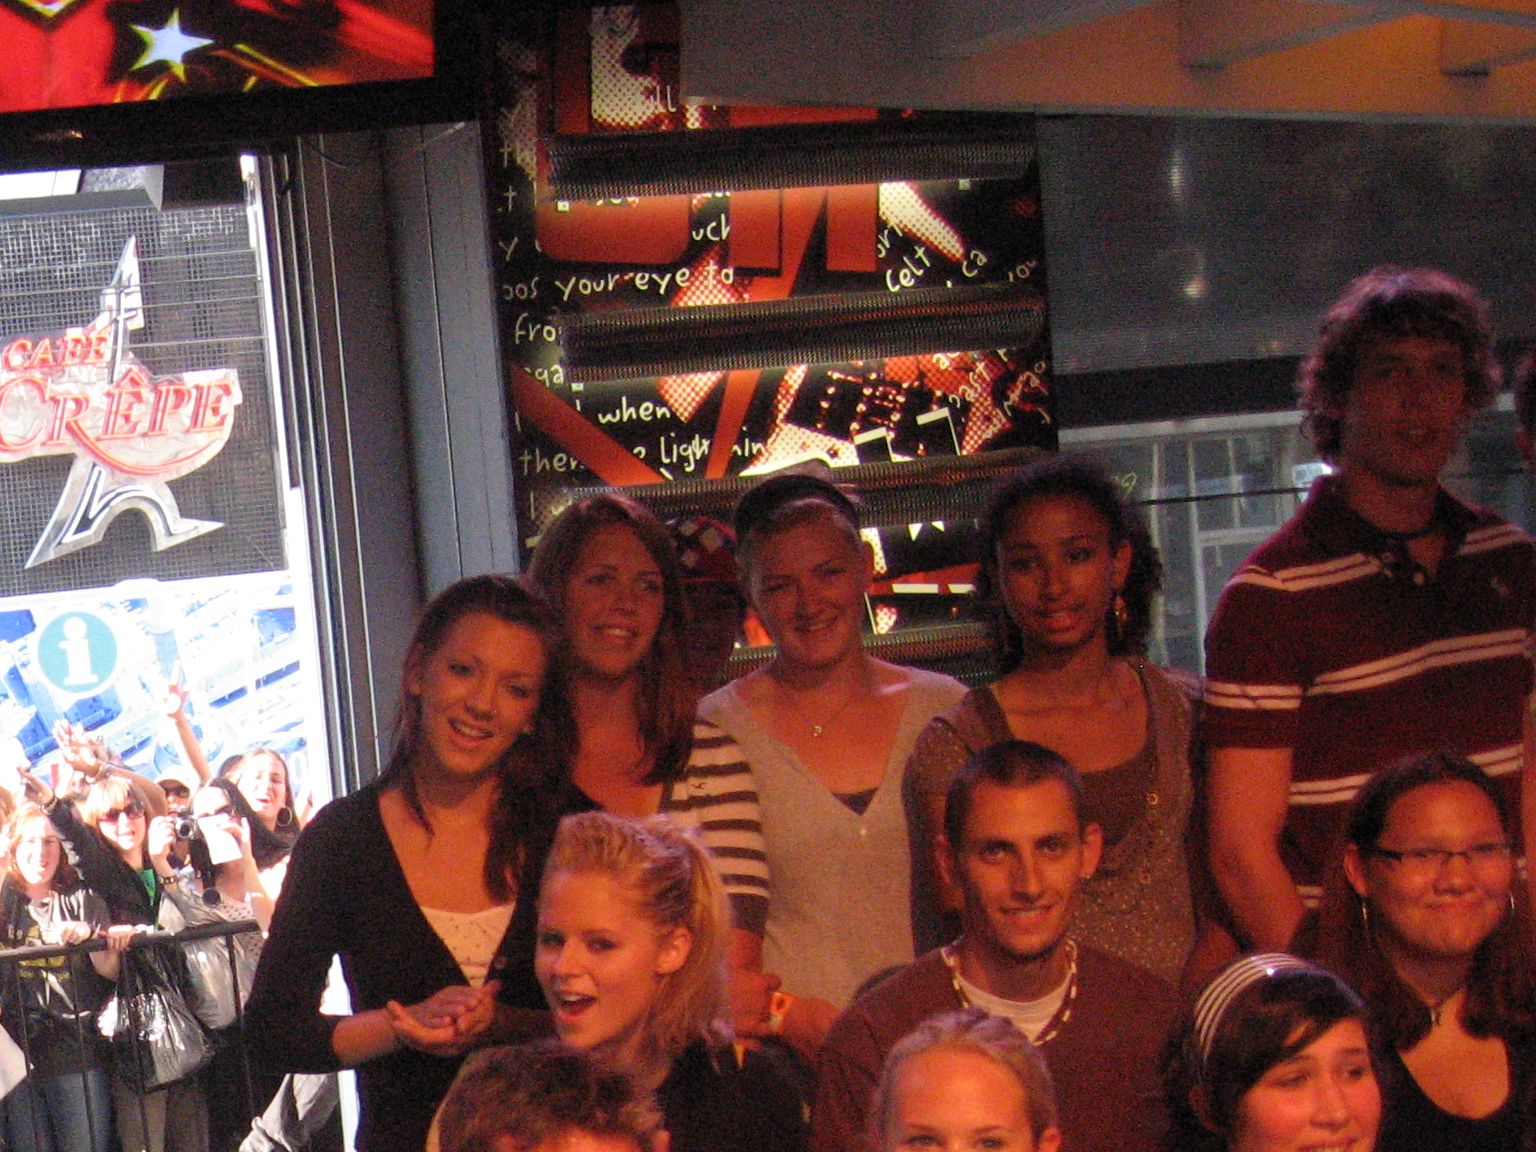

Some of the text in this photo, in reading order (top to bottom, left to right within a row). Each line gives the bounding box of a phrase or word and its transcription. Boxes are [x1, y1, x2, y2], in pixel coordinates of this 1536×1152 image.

[555, 276, 619, 302] your
[634, 267, 692, 295] eye
[597, 396, 671, 424] when
